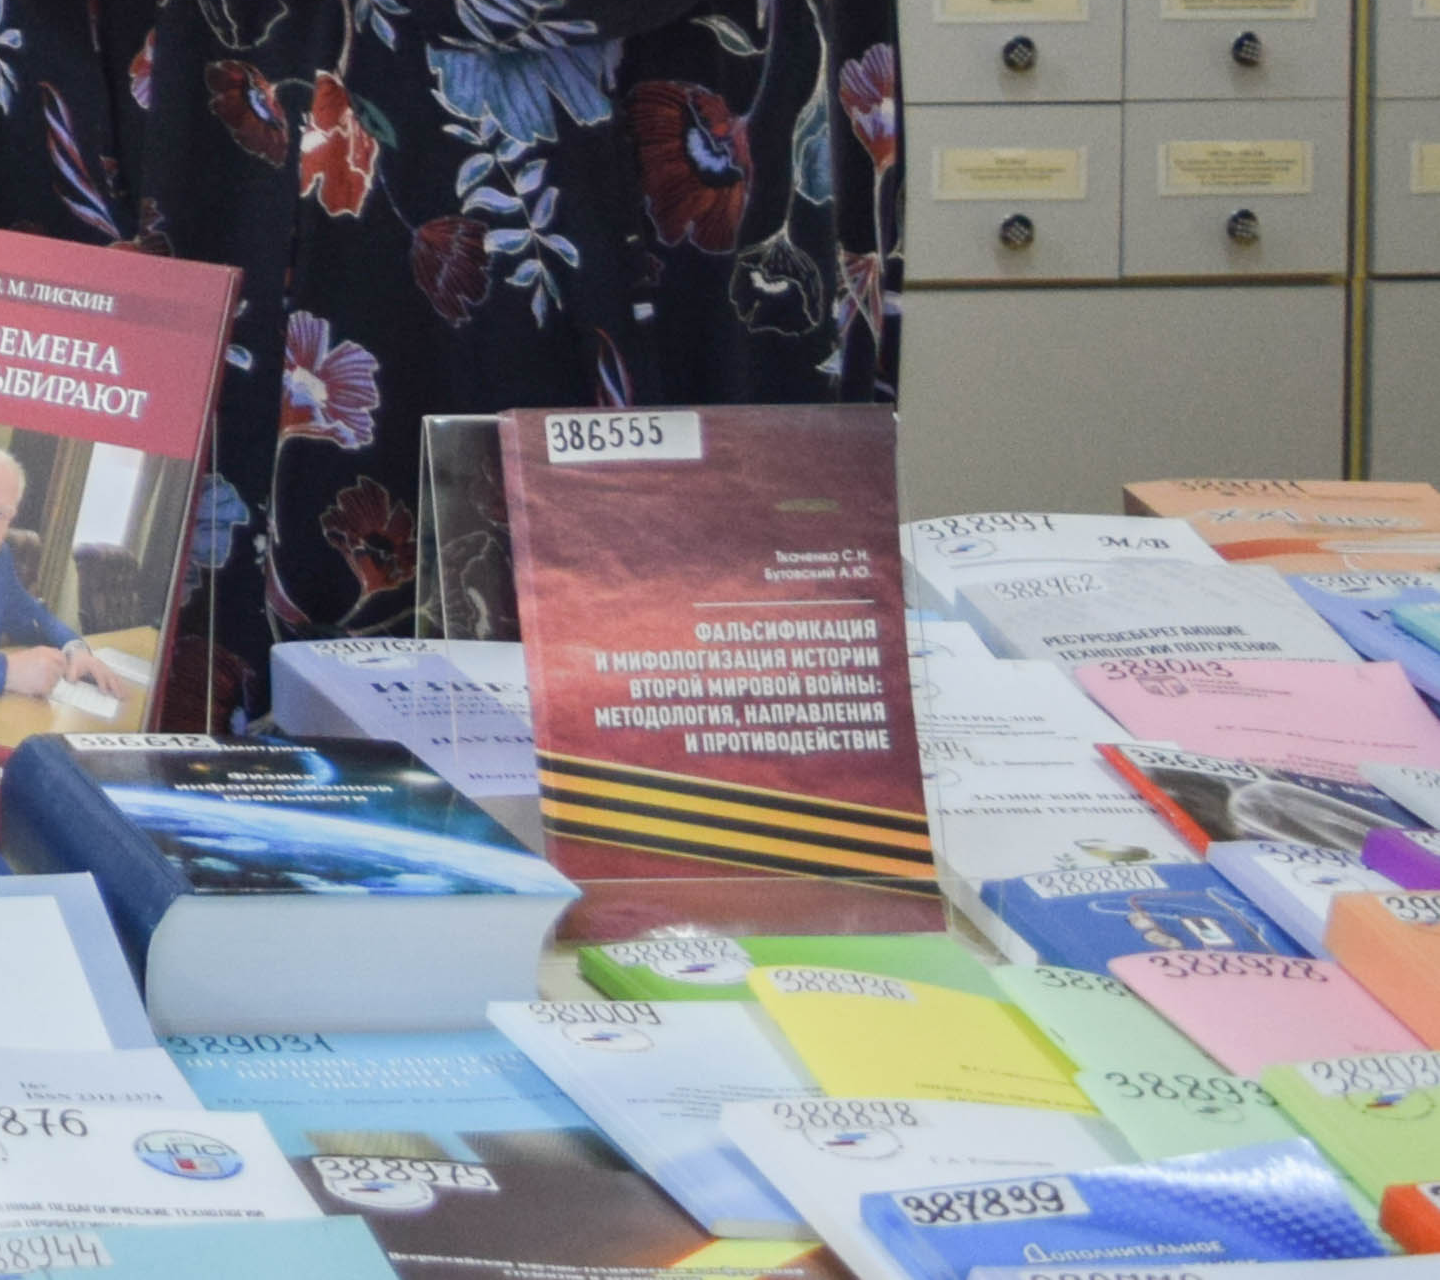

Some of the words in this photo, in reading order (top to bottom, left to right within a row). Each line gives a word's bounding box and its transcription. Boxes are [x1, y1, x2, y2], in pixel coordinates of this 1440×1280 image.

[6, 278, 28, 299] М.
[30, 282, 115, 314] ЛИСКИН
[550, 415, 665, 454] 386555
[694, 619, 878, 641] ФАЛЬСИФИКАЦИЯ
[595, 653, 609, 672] И
[612, 649, 787, 672] МИФОЛОГИЗАЦИЯ
[792, 646, 880, 668] ИСТОРИИ
[1100, 659, 1235, 681] 389043
[629, 672, 703, 700] ВТОРОЙ
[708, 670, 801, 697] МИРОВОЙ
[805, 668, 884, 696] ВОЙНЫ:
[594, 703, 742, 730] МЕТОДОЛОГИЯ,
[744, 702, 886, 725] НАПРАВЛЕНИЯ
[684, 734, 698, 753] И
[701, 728, 891, 755] ПРОТИВОДЕЙСТВИЕ
[1149, 953, 1330, 984] 388928
[902, 1179, 1065, 1225] 387839
